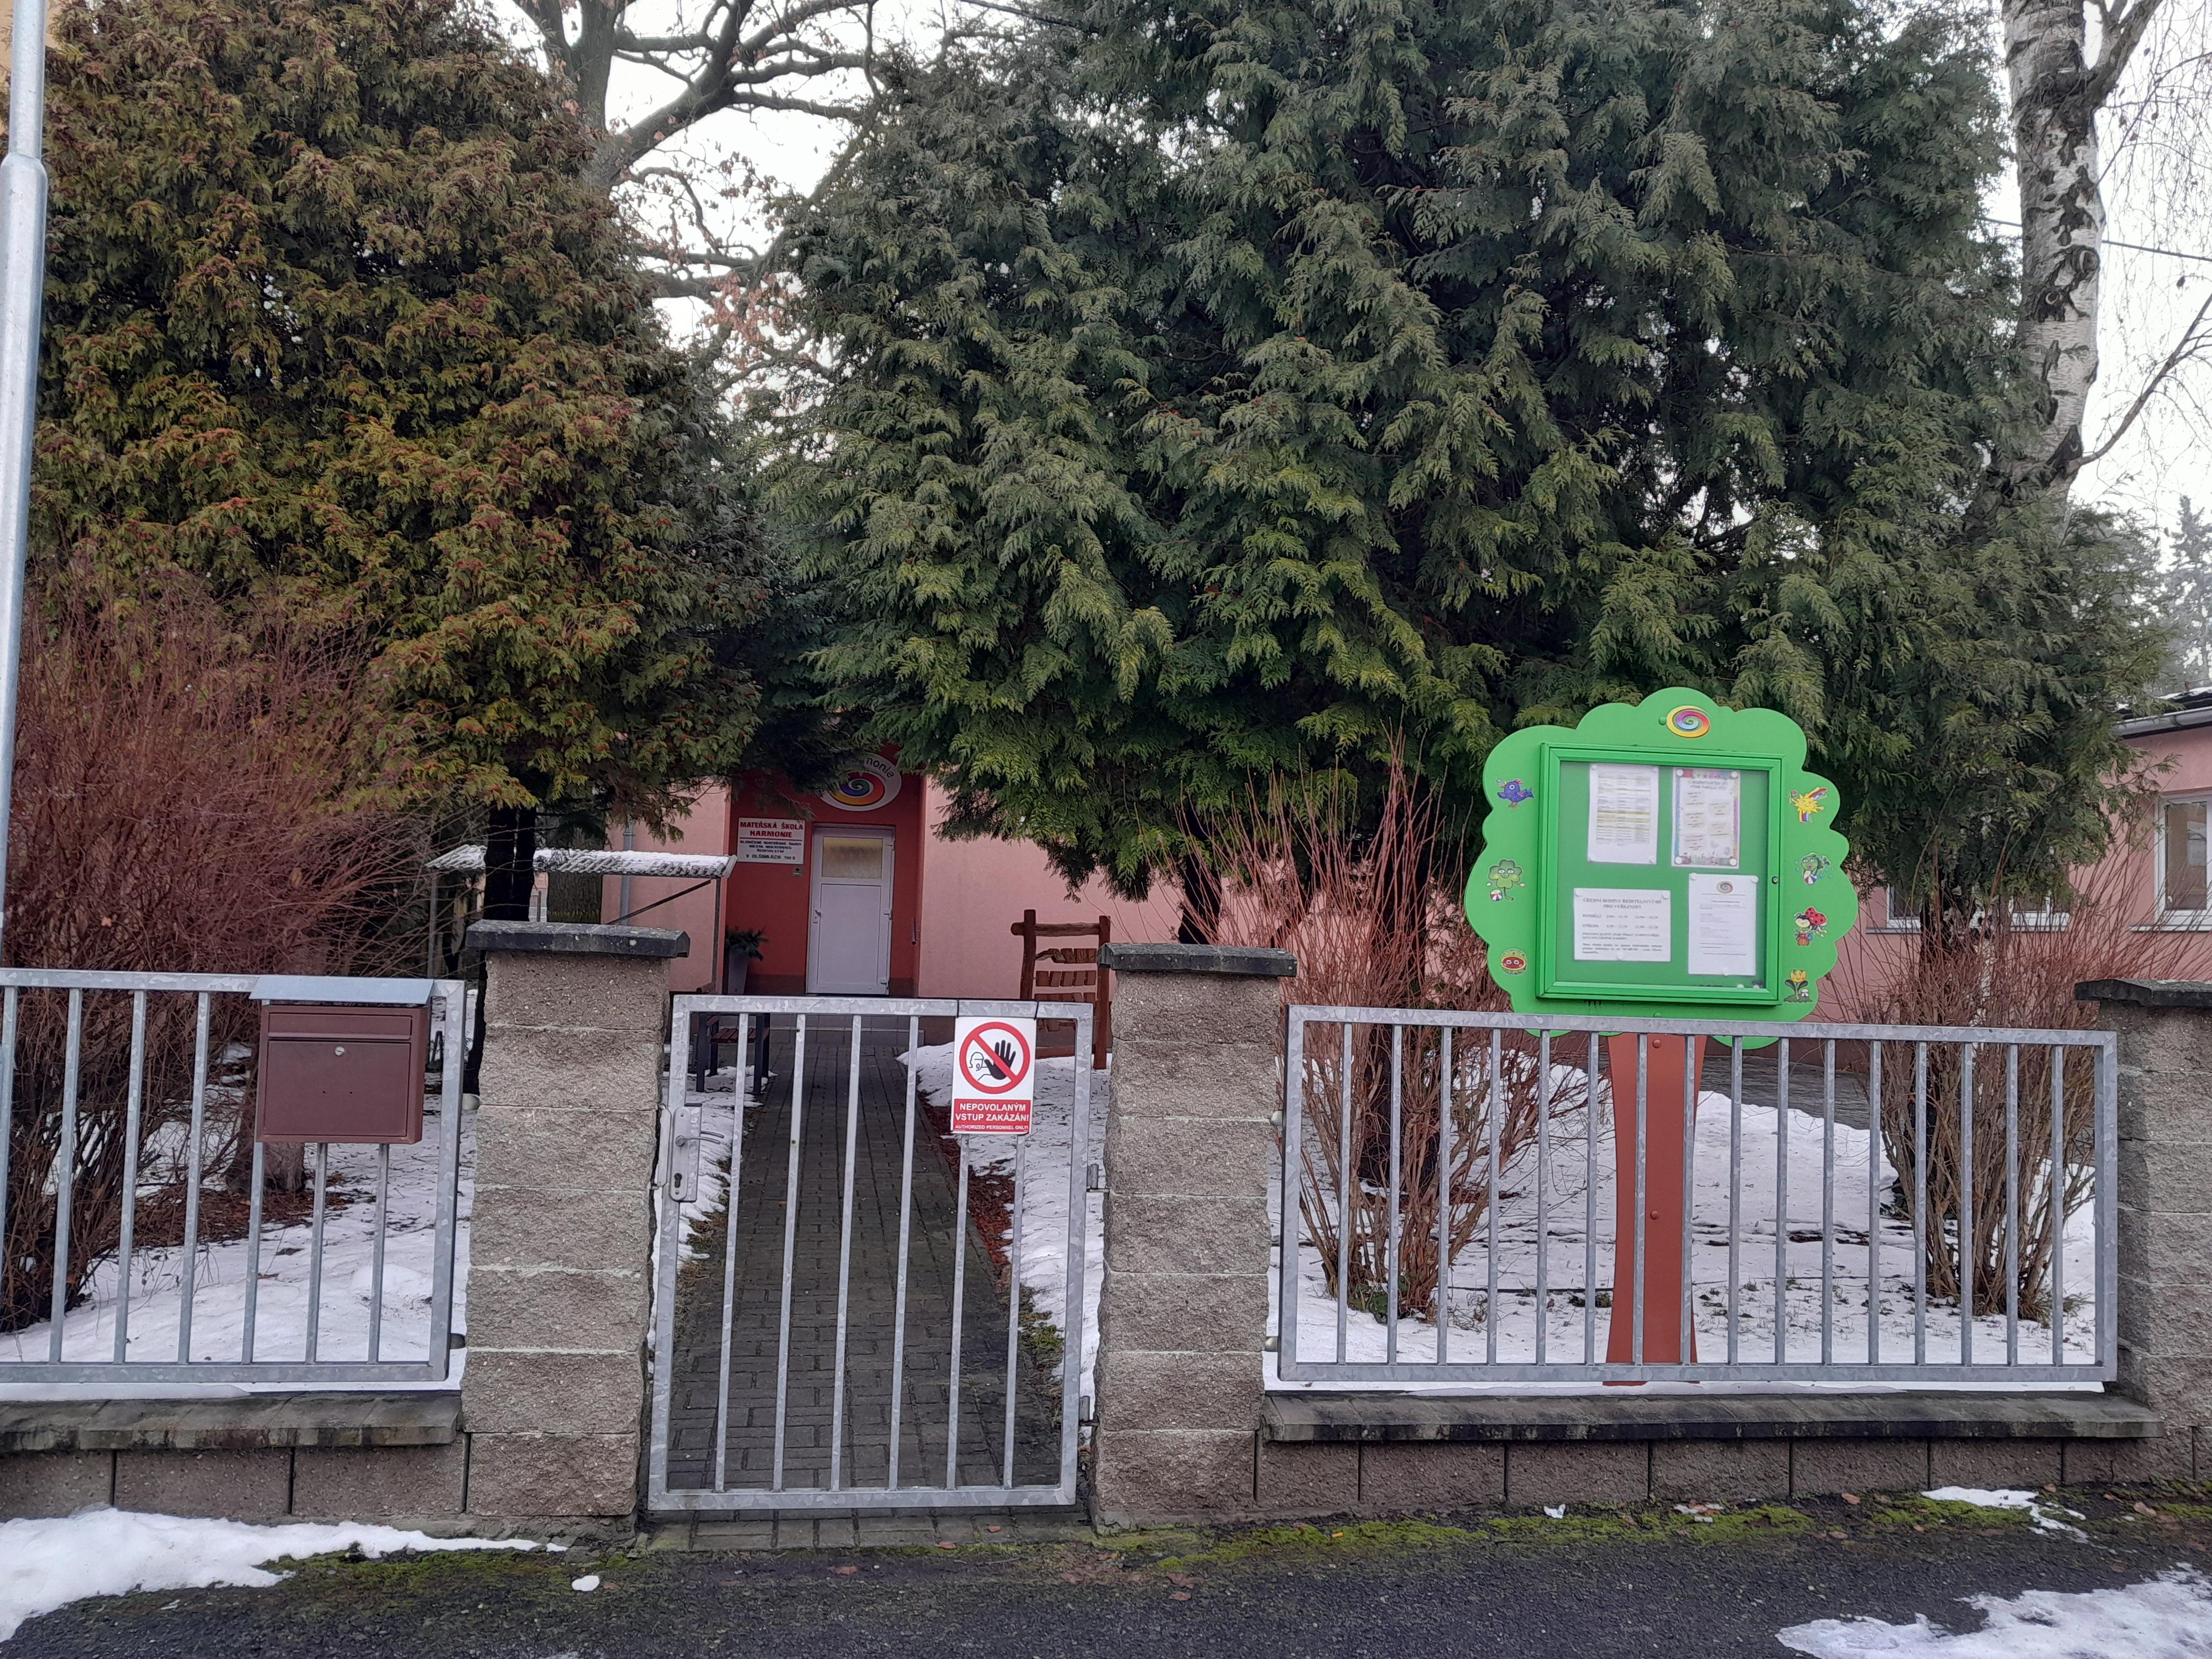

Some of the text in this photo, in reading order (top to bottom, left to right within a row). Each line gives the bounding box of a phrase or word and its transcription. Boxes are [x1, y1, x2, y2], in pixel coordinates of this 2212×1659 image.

[781, 822, 803, 830] ŠKOLA
[959, 1102, 1026, 1112] NEPOVOLANÝM
[985, 1112, 1029, 1121] ZAKÁZÁN!
